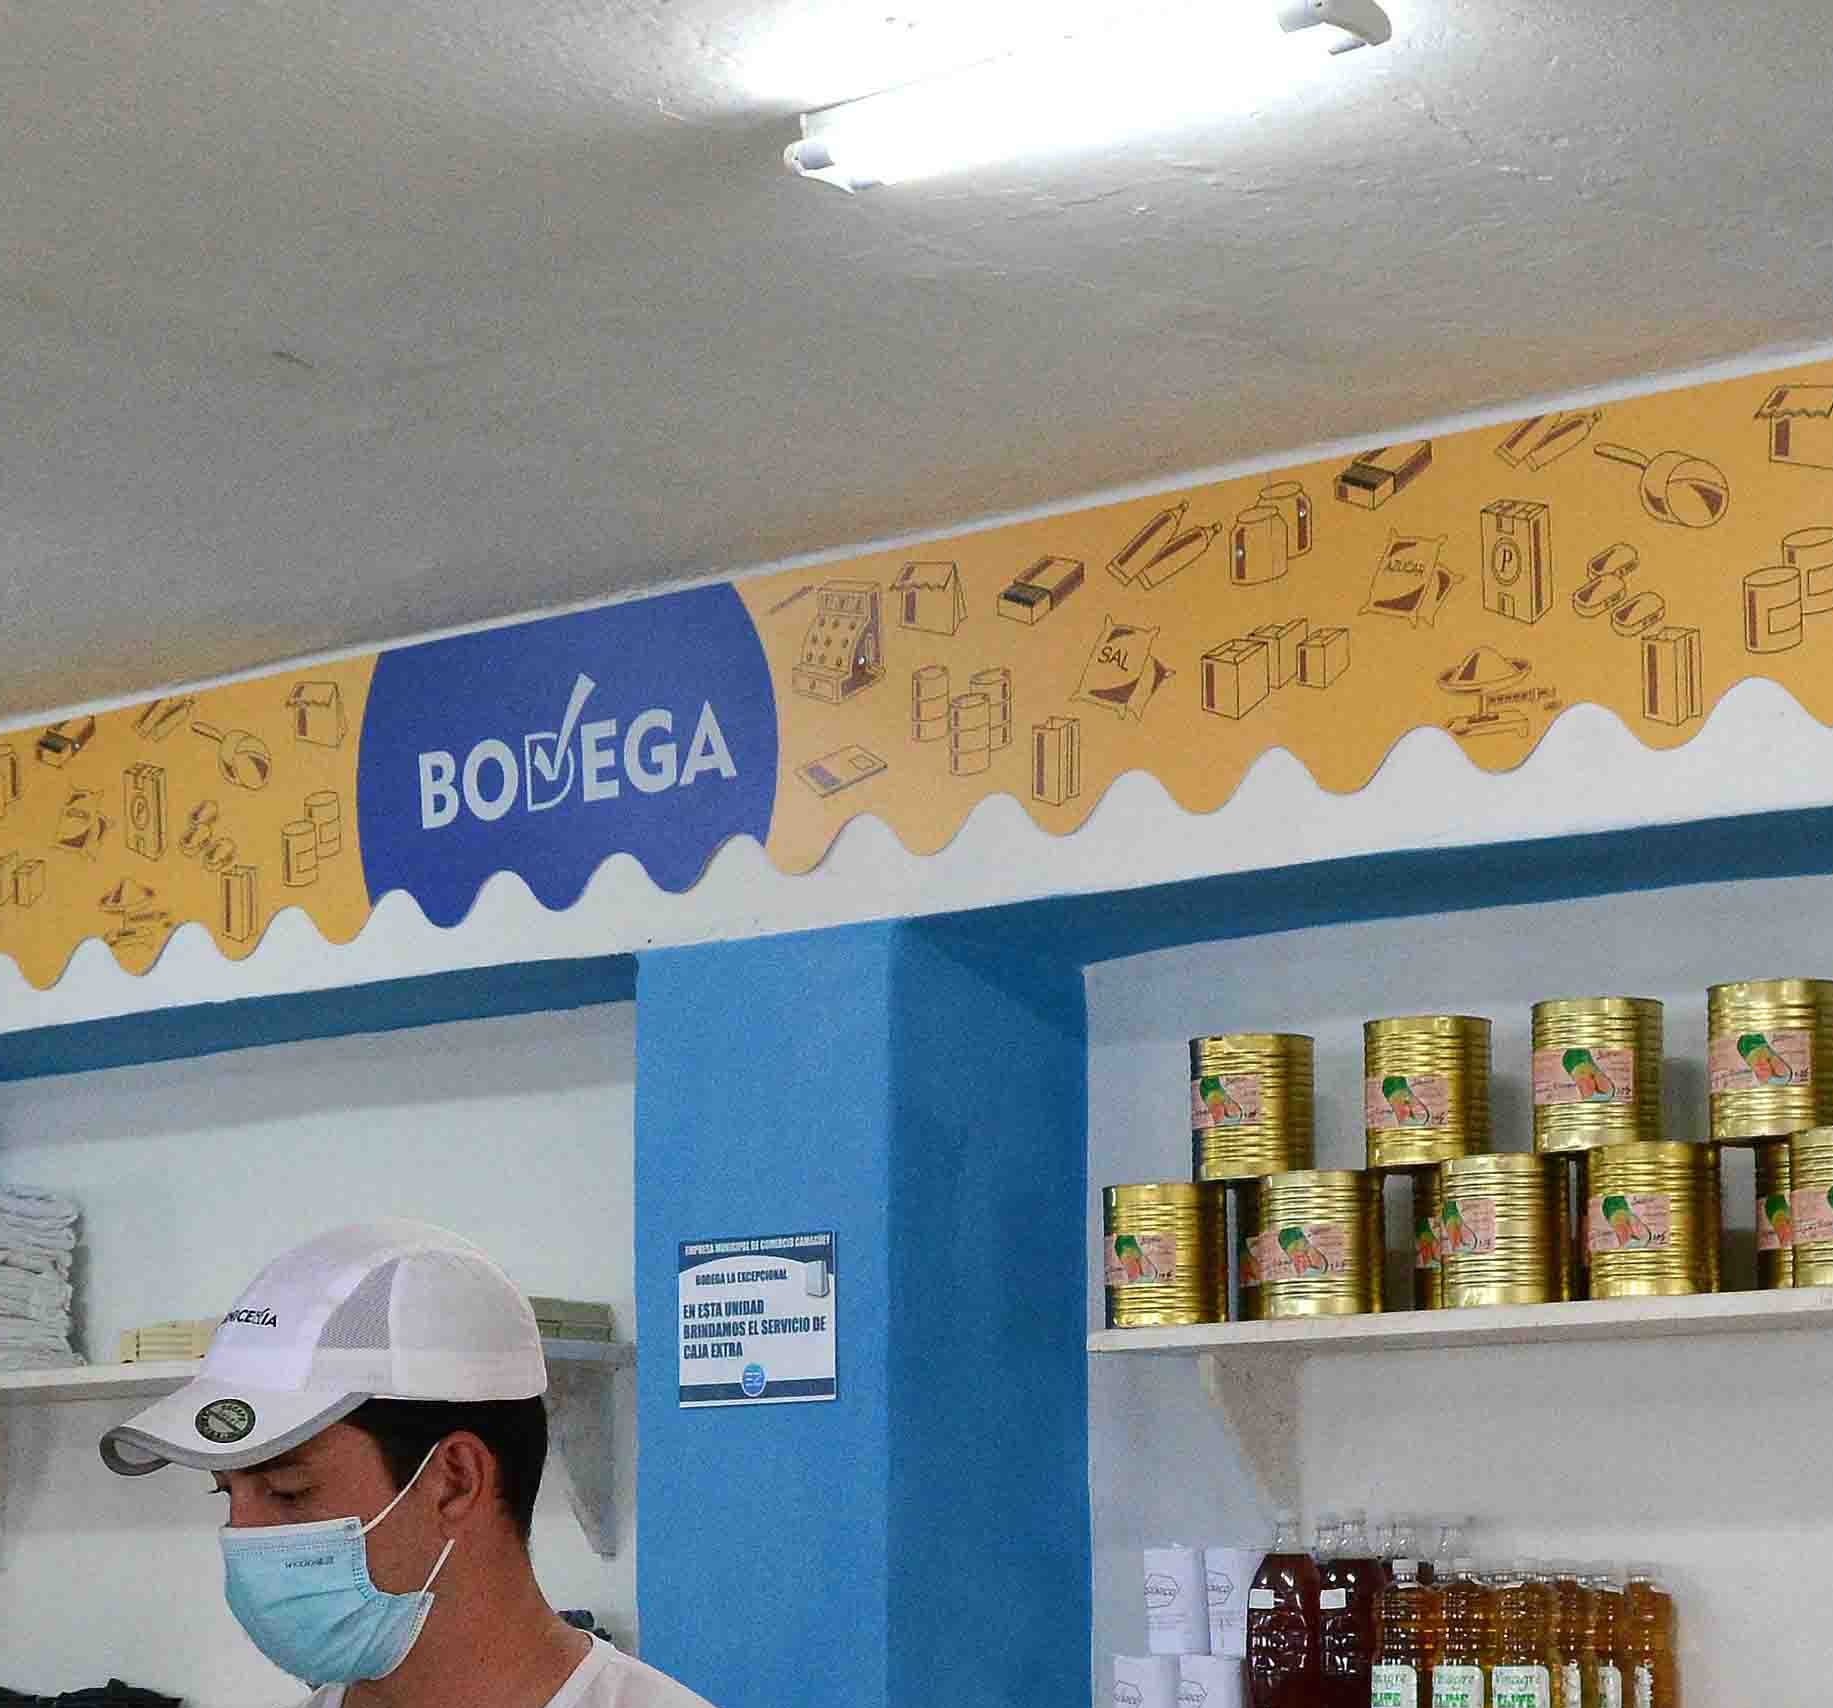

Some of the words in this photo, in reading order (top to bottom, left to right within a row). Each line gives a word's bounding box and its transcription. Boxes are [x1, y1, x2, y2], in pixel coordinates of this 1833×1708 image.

[1097, 646, 1129, 672] SAL
[419, 673, 736, 829] BODEGA
[683, 1304, 695, 1319] EN
[698, 1302, 722, 1317] ESTA
[725, 1299, 764, 1316] UNIDAD
[683, 1321, 746, 1340] BRINDAMOS
[748, 1320, 759, 1336] EL
[761, 1317, 810, 1336] SERVICIO
[812, 1316, 826, 1331] DE
[683, 1343, 709, 1360] CAJA
[711, 1341, 743, 1359] EXTRA
